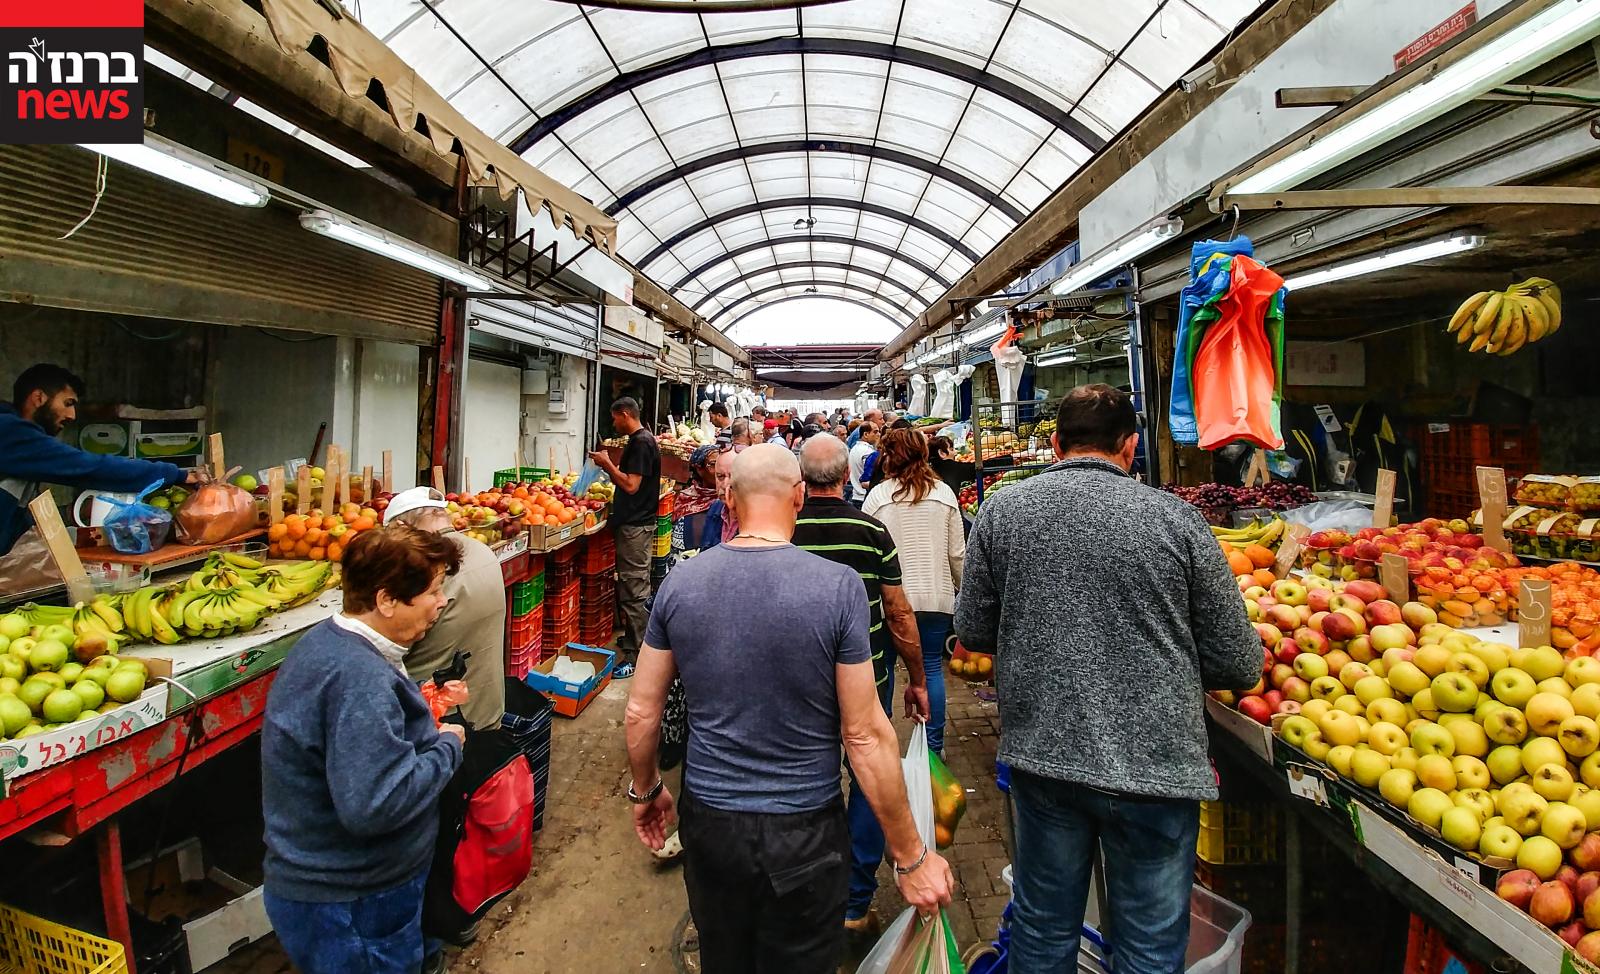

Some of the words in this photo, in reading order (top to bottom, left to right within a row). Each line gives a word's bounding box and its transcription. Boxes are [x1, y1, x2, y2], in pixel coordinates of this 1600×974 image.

[1519, 581, 1550, 620] 5
[95, 717, 134, 746] אבו
[39, 735, 87, 766] ג'בל
